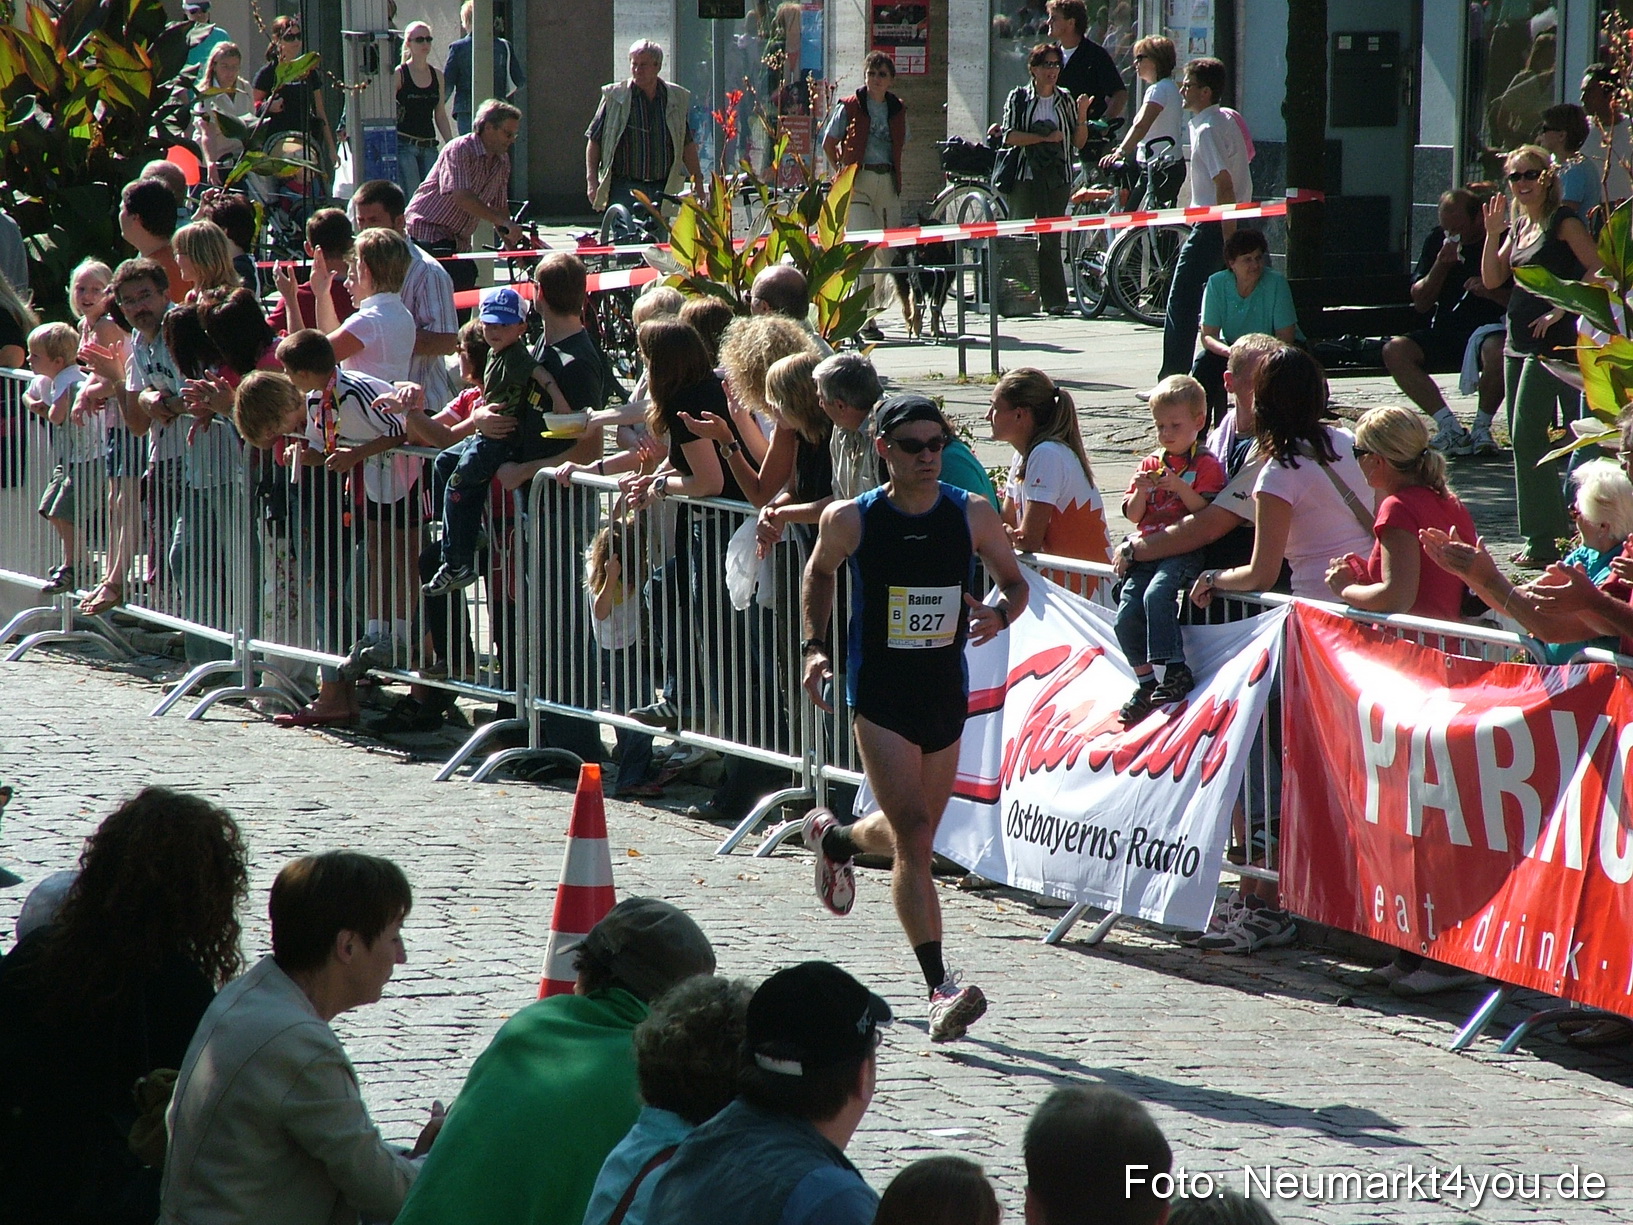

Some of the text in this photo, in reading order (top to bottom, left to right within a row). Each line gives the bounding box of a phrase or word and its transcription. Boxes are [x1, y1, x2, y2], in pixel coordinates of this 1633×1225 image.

[908, 594, 943, 606] Rainer
[893, 610, 901, 620] B
[909, 614, 945, 632] 827
[1007, 799, 1201, 878] Ostbayerns Radio
[1374, 884, 1437, 941] eat
[1473, 905, 1584, 981] drink
